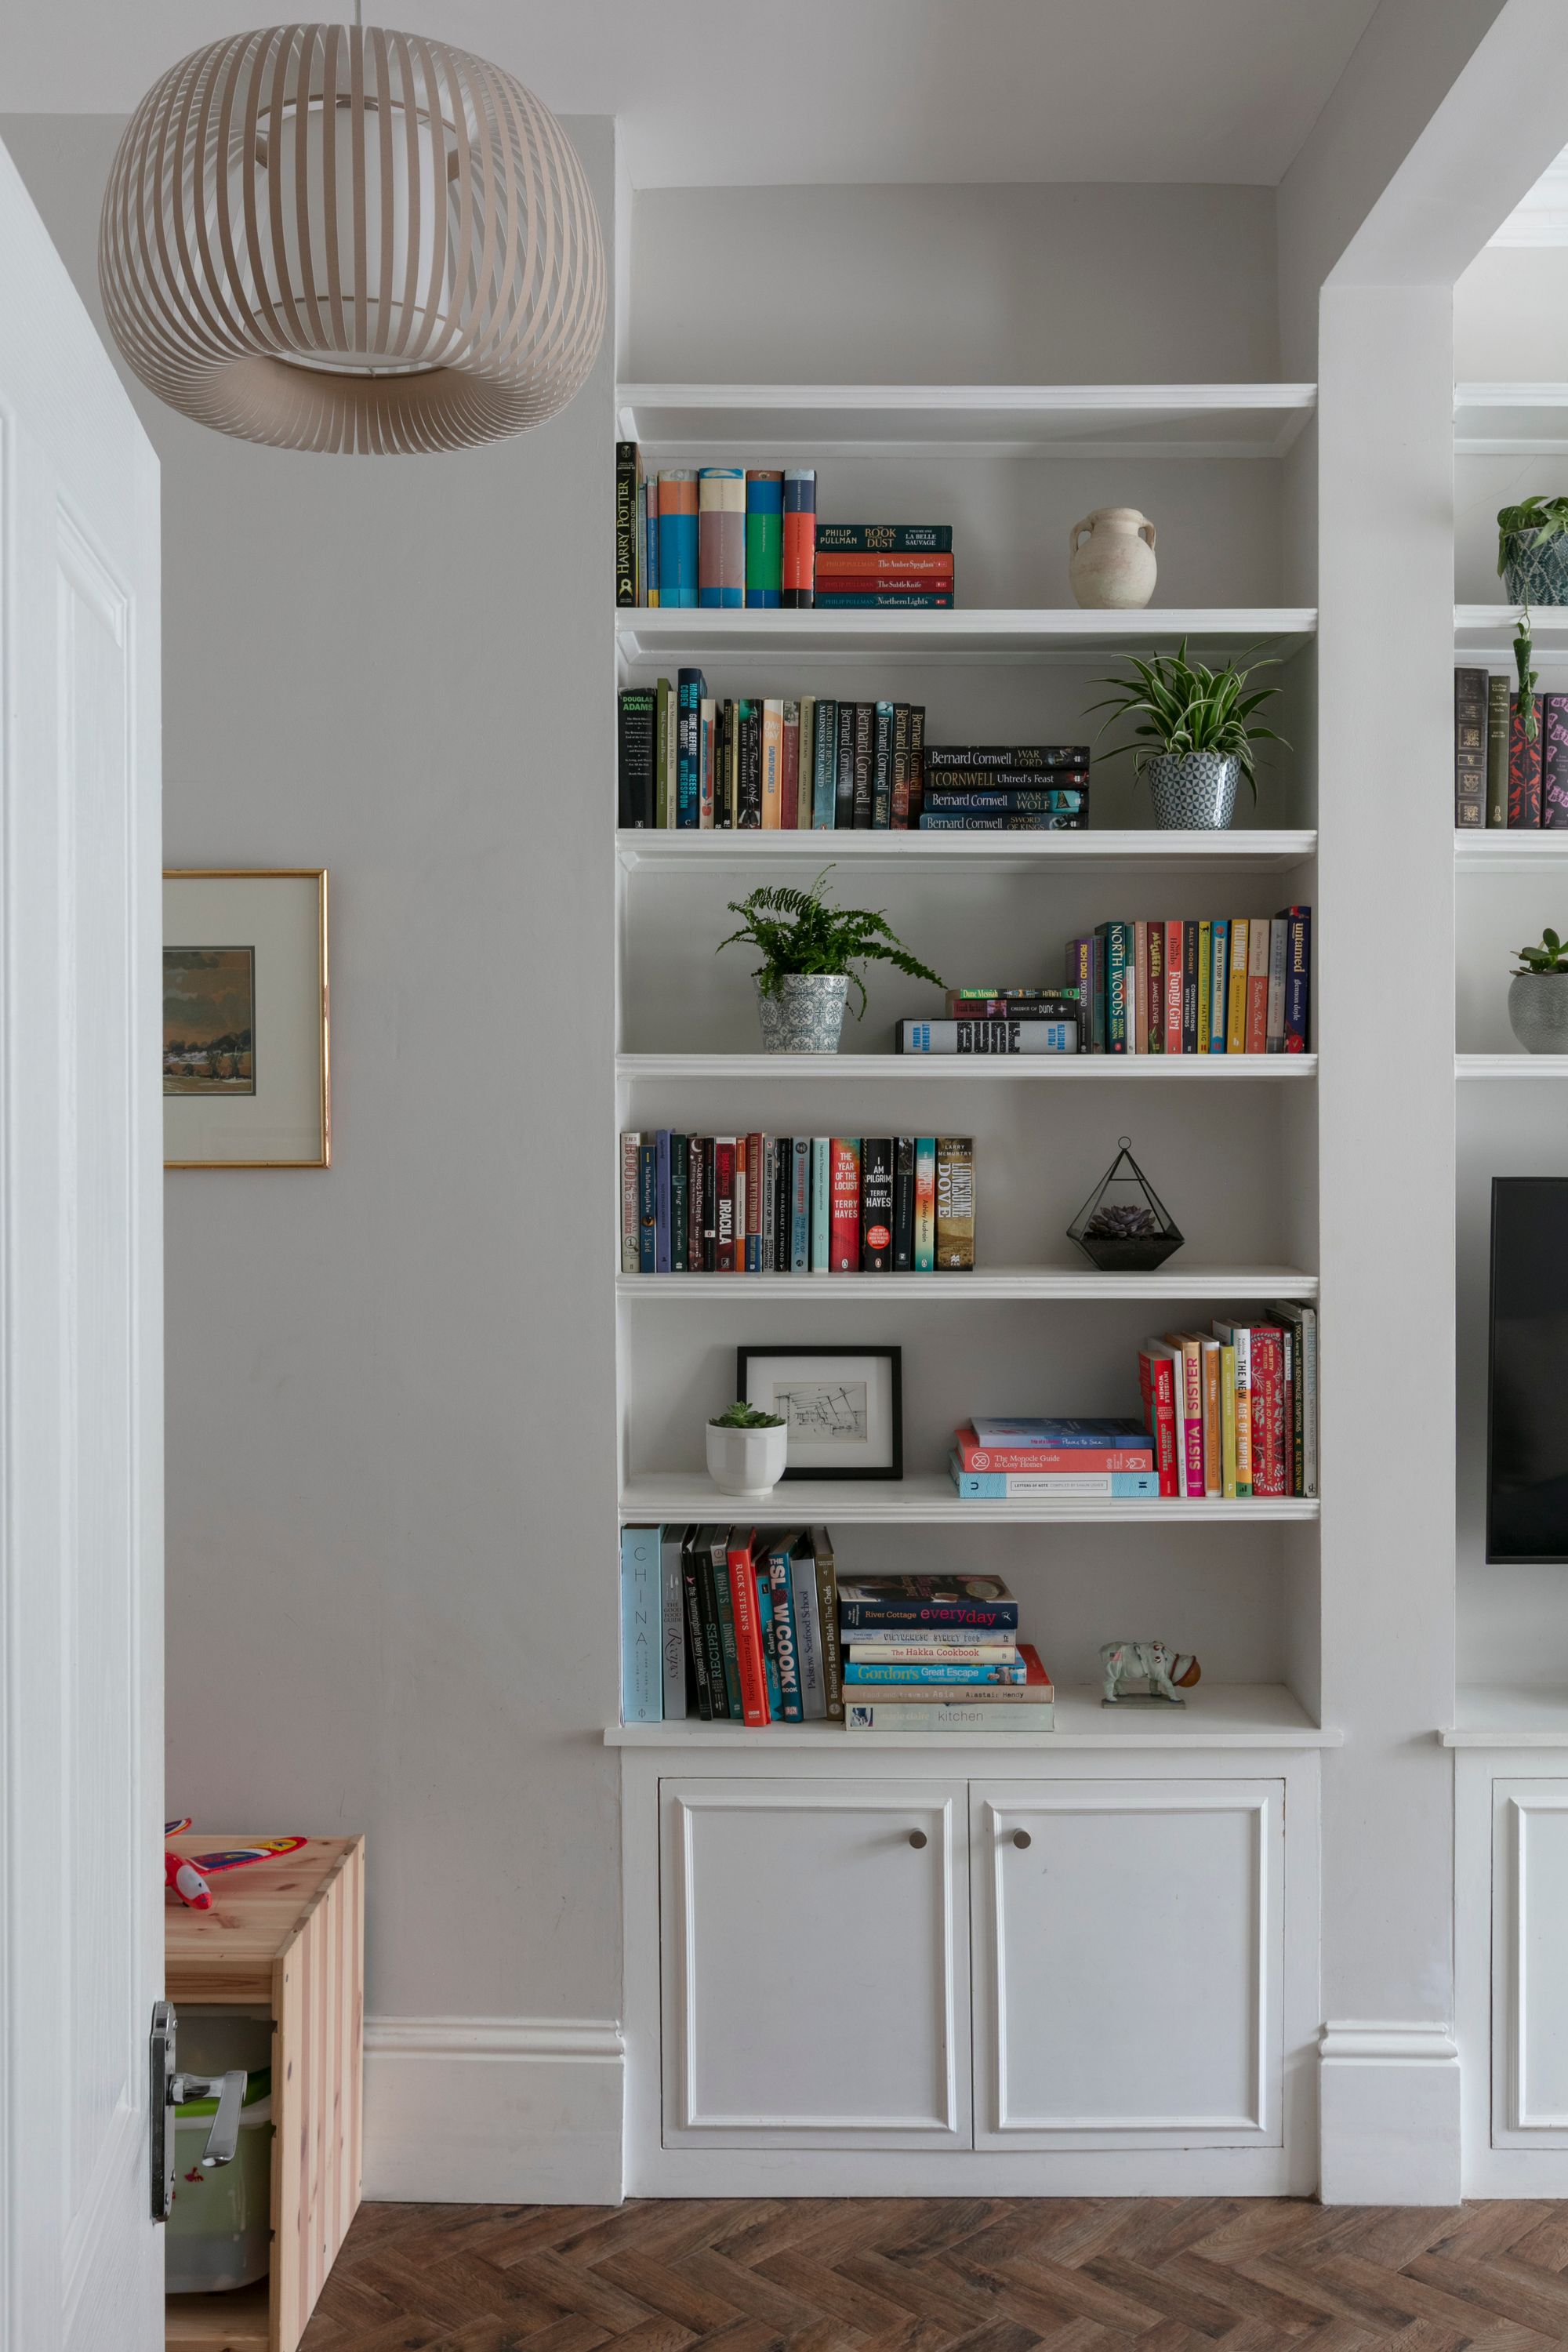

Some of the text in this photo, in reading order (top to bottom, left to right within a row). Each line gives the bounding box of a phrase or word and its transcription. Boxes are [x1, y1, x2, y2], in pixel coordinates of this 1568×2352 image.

[617, 480, 630, 528] POTTER
[865, 528, 897, 538] BOOK
[867, 539, 895, 547] DUST
[617, 530, 630, 574] HARRY
[909, 560, 934, 569] Spyglass
[907, 597, 928, 606] Lights
[680, 684, 688, 707] COBEN
[688, 684, 698, 708] HARLAN
[680, 720, 688, 749] GOODBYE
[688, 713, 697, 756] GONE BEFORE
[840, 710, 852, 787] Bernard Cornwell
[855, 709, 872, 804] Bernard Cornwell
[877, 717, 890, 790] Bernard Cornwell
[895, 710, 909, 795] Bernard Cornwell
[910, 714, 924, 790] Bernard Cornwell
[931, 751, 1011, 764] Bernard Cornwell
[1017, 750, 1040, 758] WAR
[680, 760, 688, 808] WITHERSPOON
[688, 773, 698, 795] REESE
[935, 772, 995, 786] CORNWELL
[996, 774, 1031, 783] Uhtred's
[1033, 775, 1054, 783] Feast
[932, 793, 1007, 806] Bernard Cornwell
[1016, 792, 1042, 800] WAR
[1016, 800, 1050, 810] WOLF
[927, 816, 1002, 829] Bernard Cornwell
[1168, 937, 1178, 965] Hornby
[1233, 924, 1247, 971] YELLOWFACE
[1294, 923, 1305, 973] untamed
[1111, 925, 1123, 1016] NORTH WOODS
[978, 989, 998, 998] Messiah
[1168, 971, 1181, 1030] Funny Girl
[921, 1023, 930, 1051] HERBERT
[956, 1022, 1021, 1053] DUNE
[837, 1162, 855, 1171] YEAR
[877, 1156, 880, 1165] I
[834, 1181, 858, 1190] LOCUST
[835, 1172, 844, 1181] OF
[866, 1174, 891, 1183] PILGRIM
[917, 1159, 933, 1196] WHISPERS
[938, 1163, 951, 1218] DOVE
[952, 1162, 972, 1218] LONESOME
[834, 1200, 858, 1209] TERRY
[834, 1210, 858, 1218] HAYES
[866, 1197, 891, 1207] HAYES
[719, 1200, 731, 1245] DRACULA
[1186, 1357, 1199, 1410] SISTER
[1237, 1359, 1248, 1470] THE NEW AGE OF EMPIRE
[1188, 1425, 1200, 1470] SISTA
[633, 1546, 648, 1646] CHINA
[717, 1572, 729, 1603] WHAT'S
[824, 1584, 833, 1604] Chefs
[886, 1610, 916, 1620] Cottage
[688, 1586, 706, 1686] the hummingbird bakery cookbook
[722, 1623, 735, 1658] DINNER?
[735, 1563, 757, 1700] RICK STEIN'S far eastern odyssey
[800, 1591, 817, 1690] Padstow Seafood School
[826, 1622, 835, 1641] Dish
[884, 1633, 962, 1642] VIETNAMESE STREET
[706, 1623, 722, 1679] RECIPES
[776, 1624, 797, 1687] COOK
[828, 1643, 837, 1661] Best
[936, 1648, 980, 1657] Cookbook
[829, 1664, 838, 1698] Britain's
[858, 1667, 979, 1681] Gordon's Great Escape
[938, 1710, 984, 1722] kitchen
